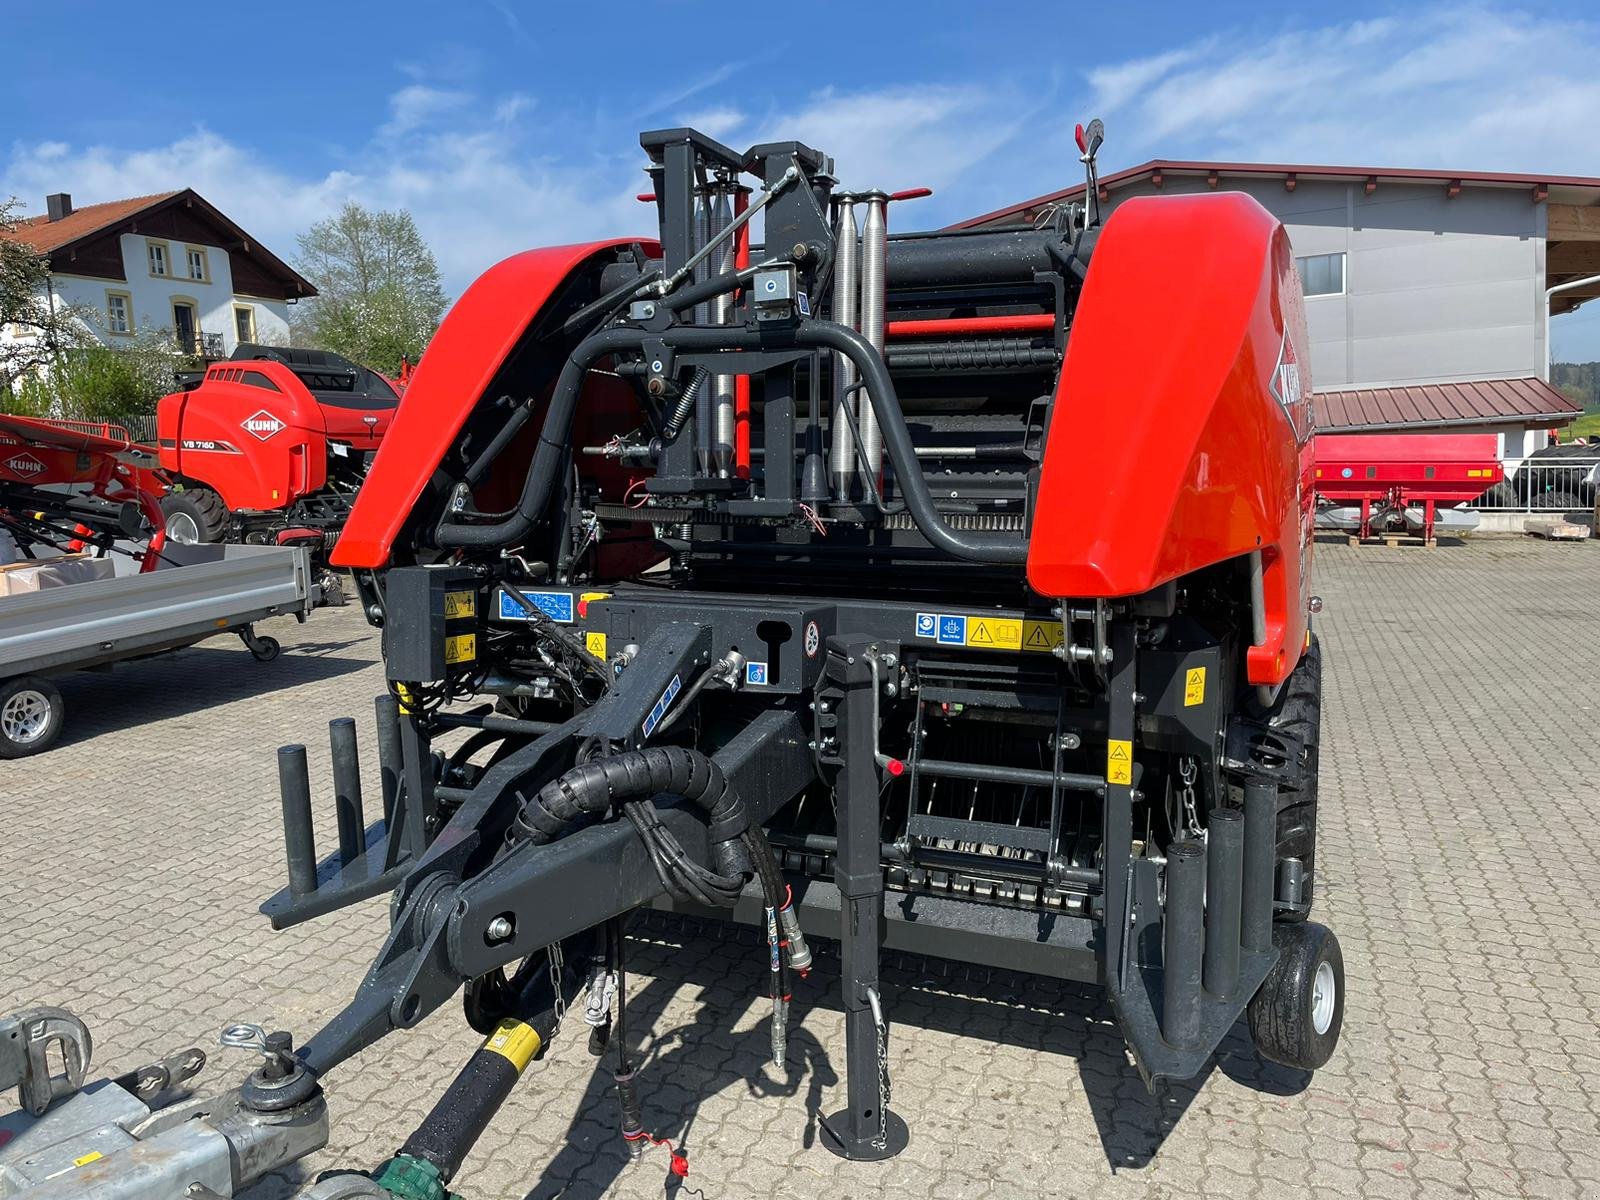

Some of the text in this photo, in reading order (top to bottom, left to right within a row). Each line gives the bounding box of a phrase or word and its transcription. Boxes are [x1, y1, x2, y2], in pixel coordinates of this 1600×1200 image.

[247, 421, 279, 431] KUHN
[196, 441, 215, 449] 7160
[10, 460, 41, 472] KUHN
